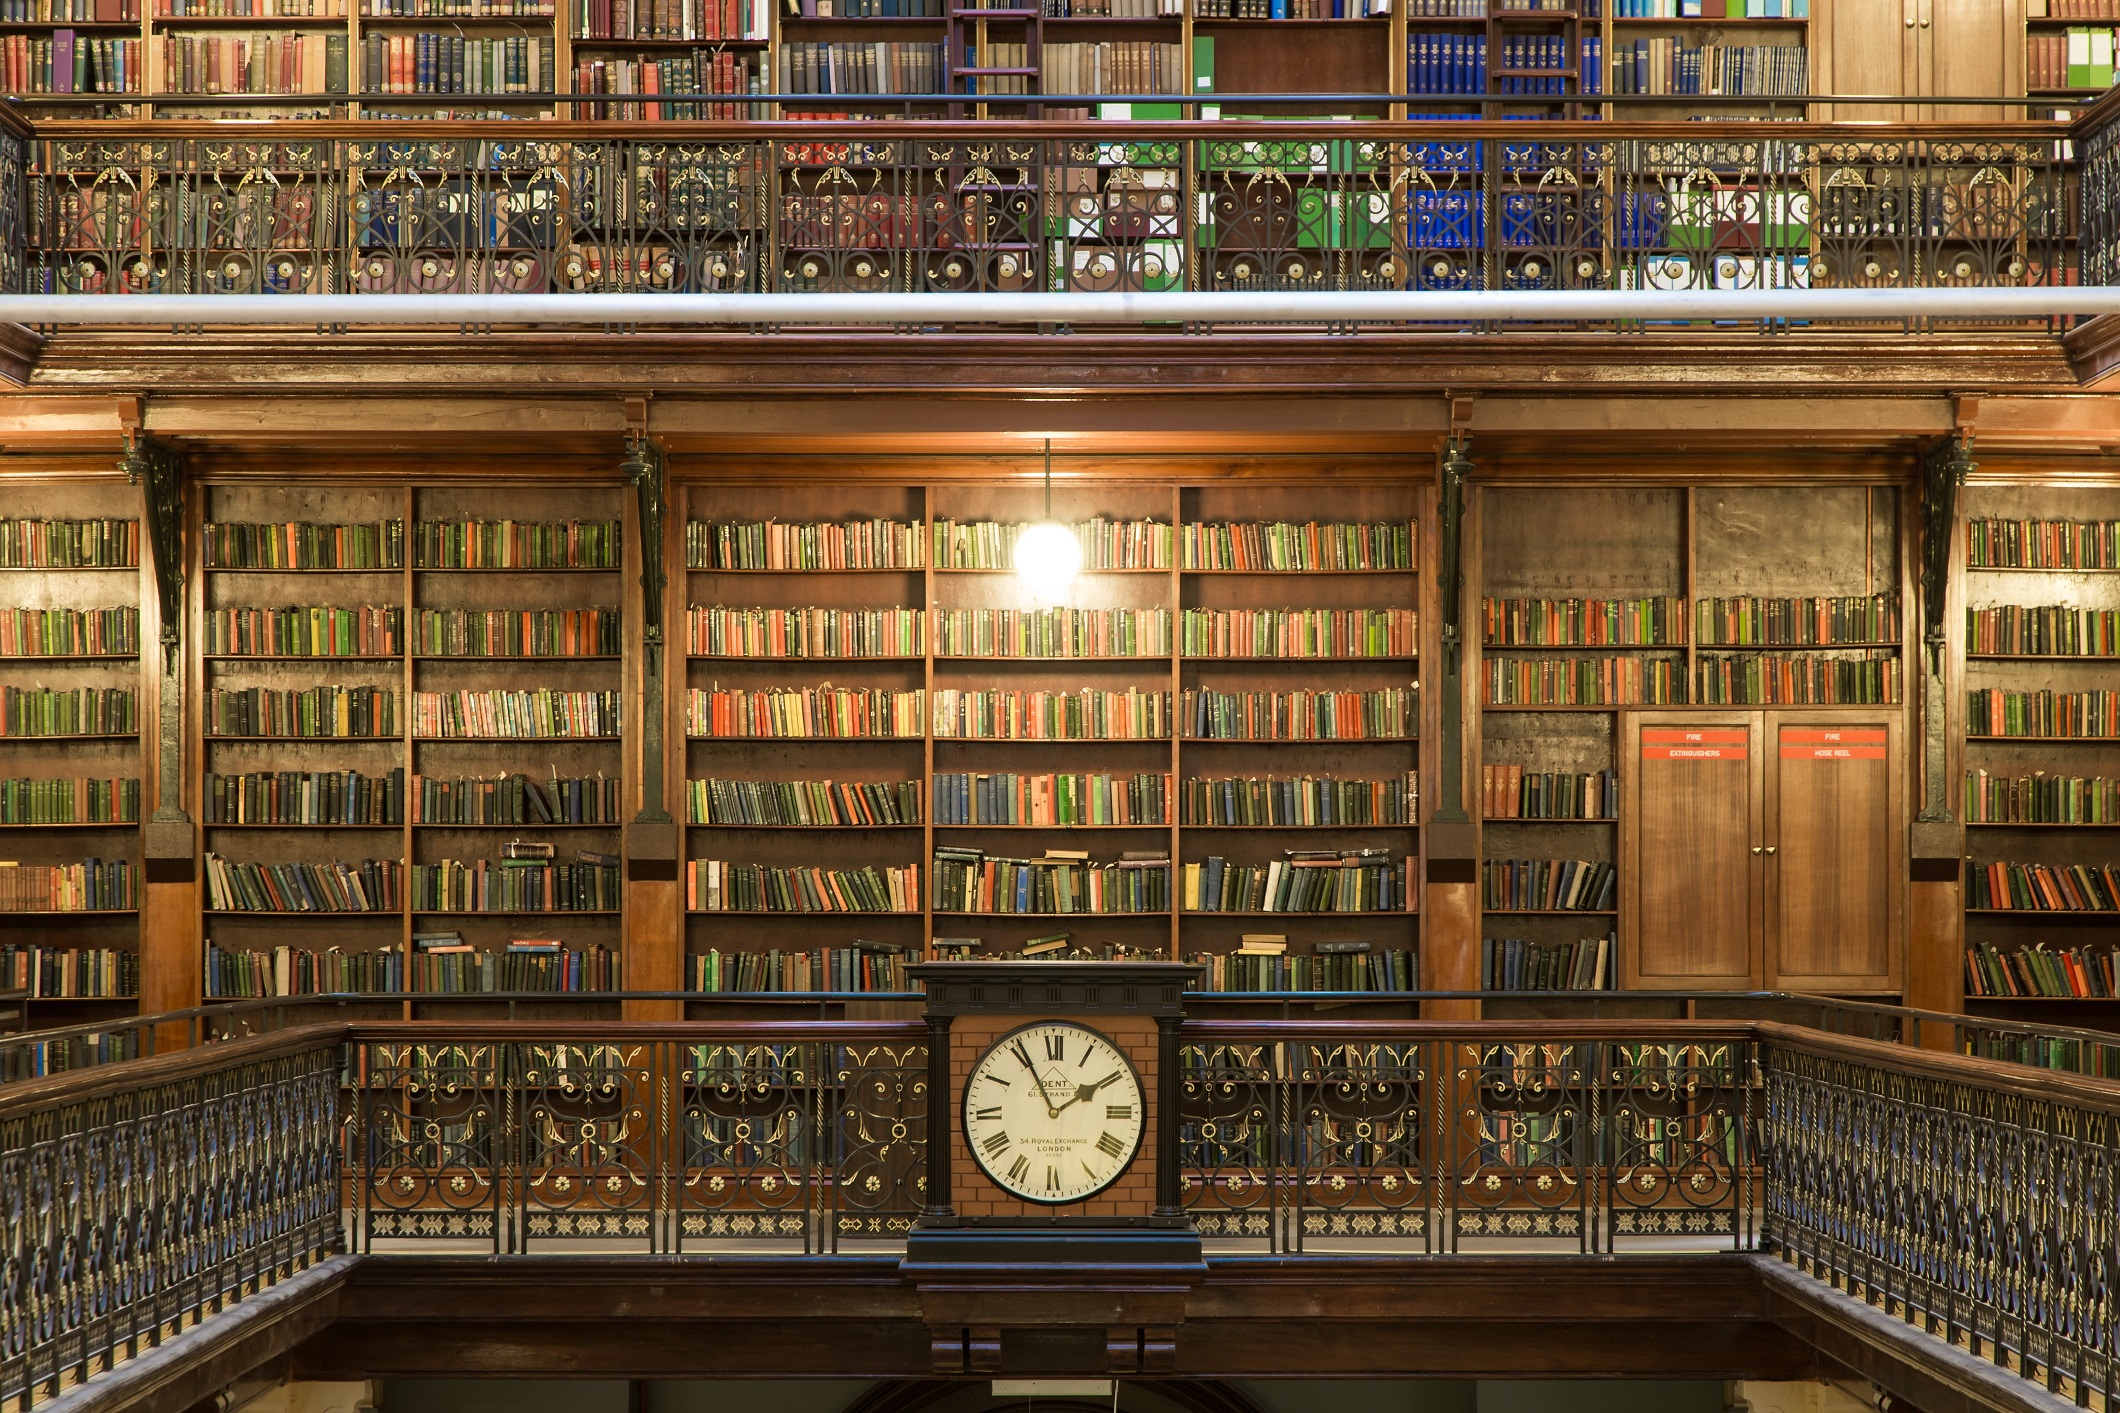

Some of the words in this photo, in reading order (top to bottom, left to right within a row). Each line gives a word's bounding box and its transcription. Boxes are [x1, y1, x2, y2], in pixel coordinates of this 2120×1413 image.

[1686, 733, 1702, 741] FIRE
[1825, 733, 1841, 741] FIRE
[1814, 749, 1833, 757] HOSE
[1834, 749, 1851, 757] REEL
[1044, 1035, 1064, 1062] XII
[1078, 1043, 1094, 1068] I
[1106, 1105, 1132, 1120] III
